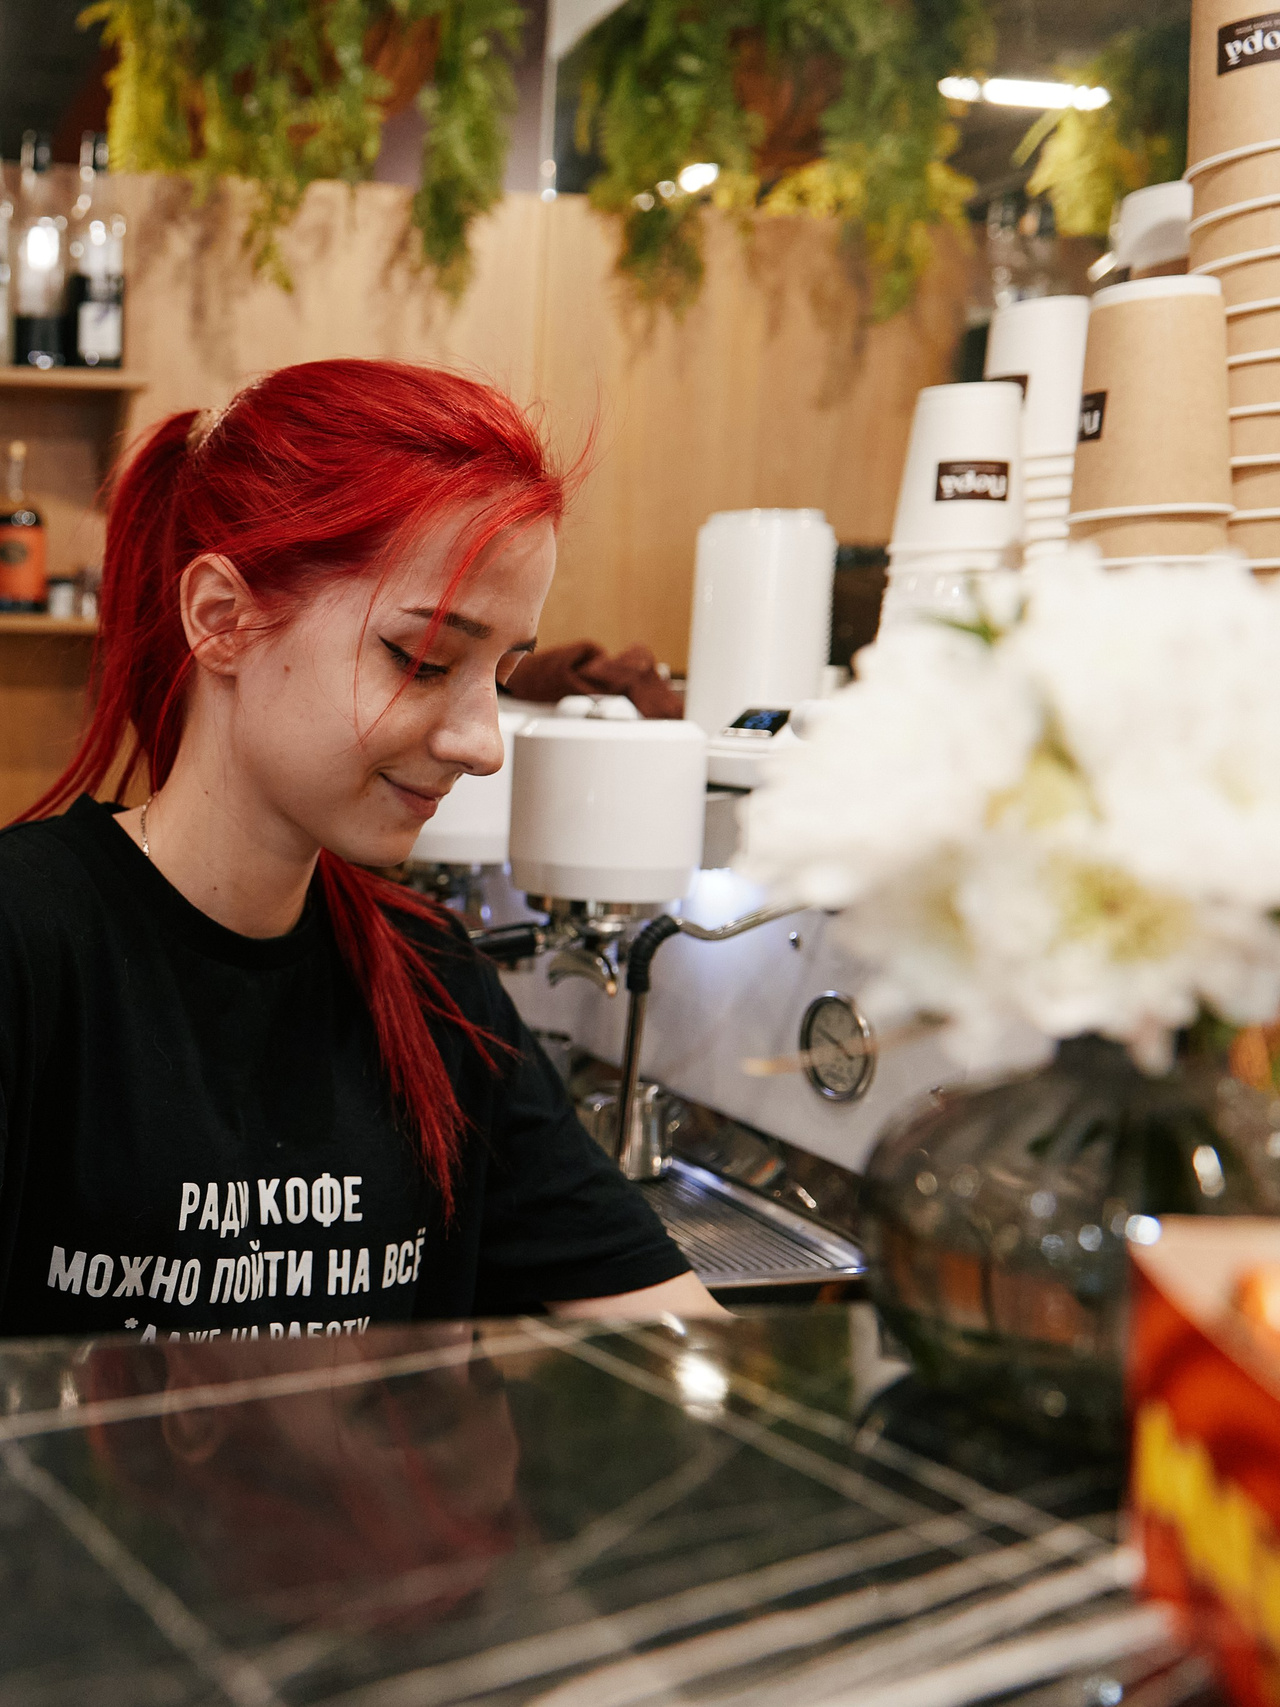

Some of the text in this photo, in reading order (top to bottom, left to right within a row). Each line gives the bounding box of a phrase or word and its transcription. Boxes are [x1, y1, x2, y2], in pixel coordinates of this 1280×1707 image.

[178, 1172, 363, 1239] РАДИ КОФЕ
[47, 1227, 426, 1306] МОЖНО ПОЙТИ НА ВСЁ
